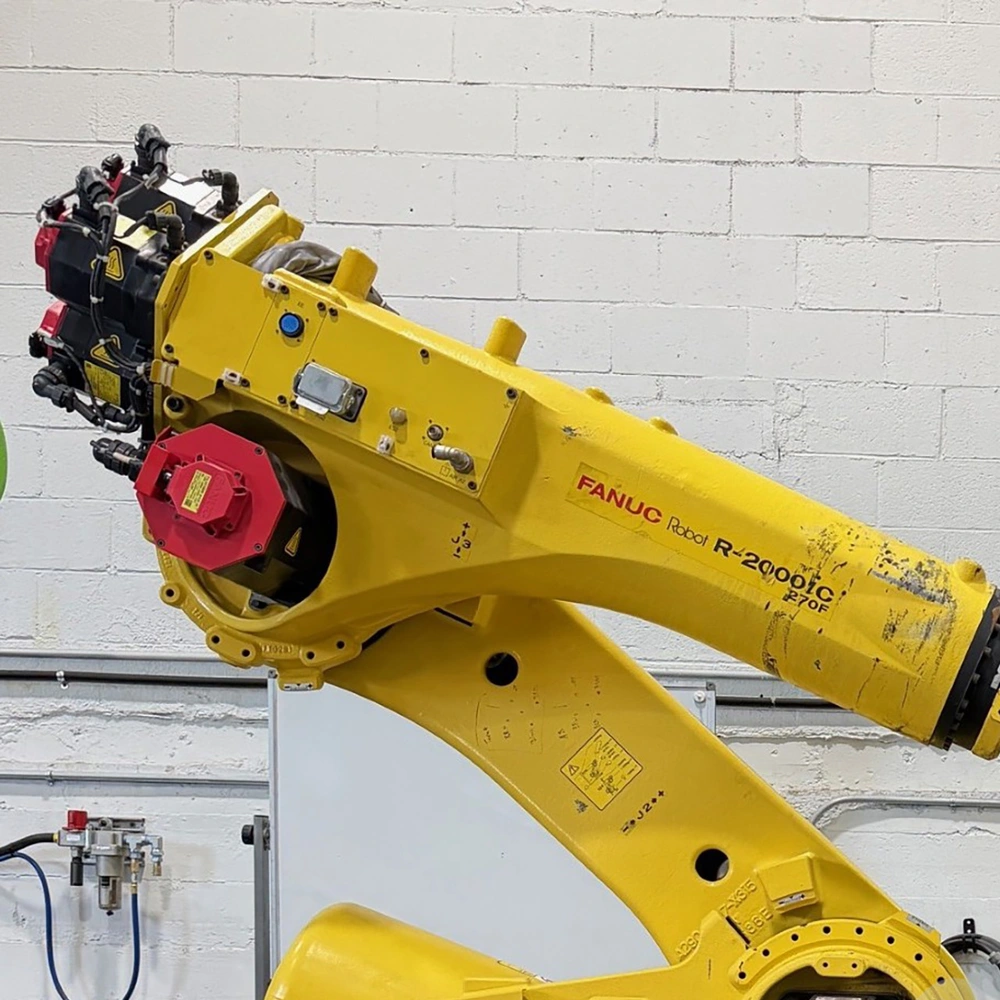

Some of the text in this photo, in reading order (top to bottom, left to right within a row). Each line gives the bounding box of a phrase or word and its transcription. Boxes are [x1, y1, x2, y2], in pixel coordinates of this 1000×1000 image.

[577, 475, 662, 523] FANUC
[666, 516, 708, 546] Robot
[784, 590, 829, 613] 270F
